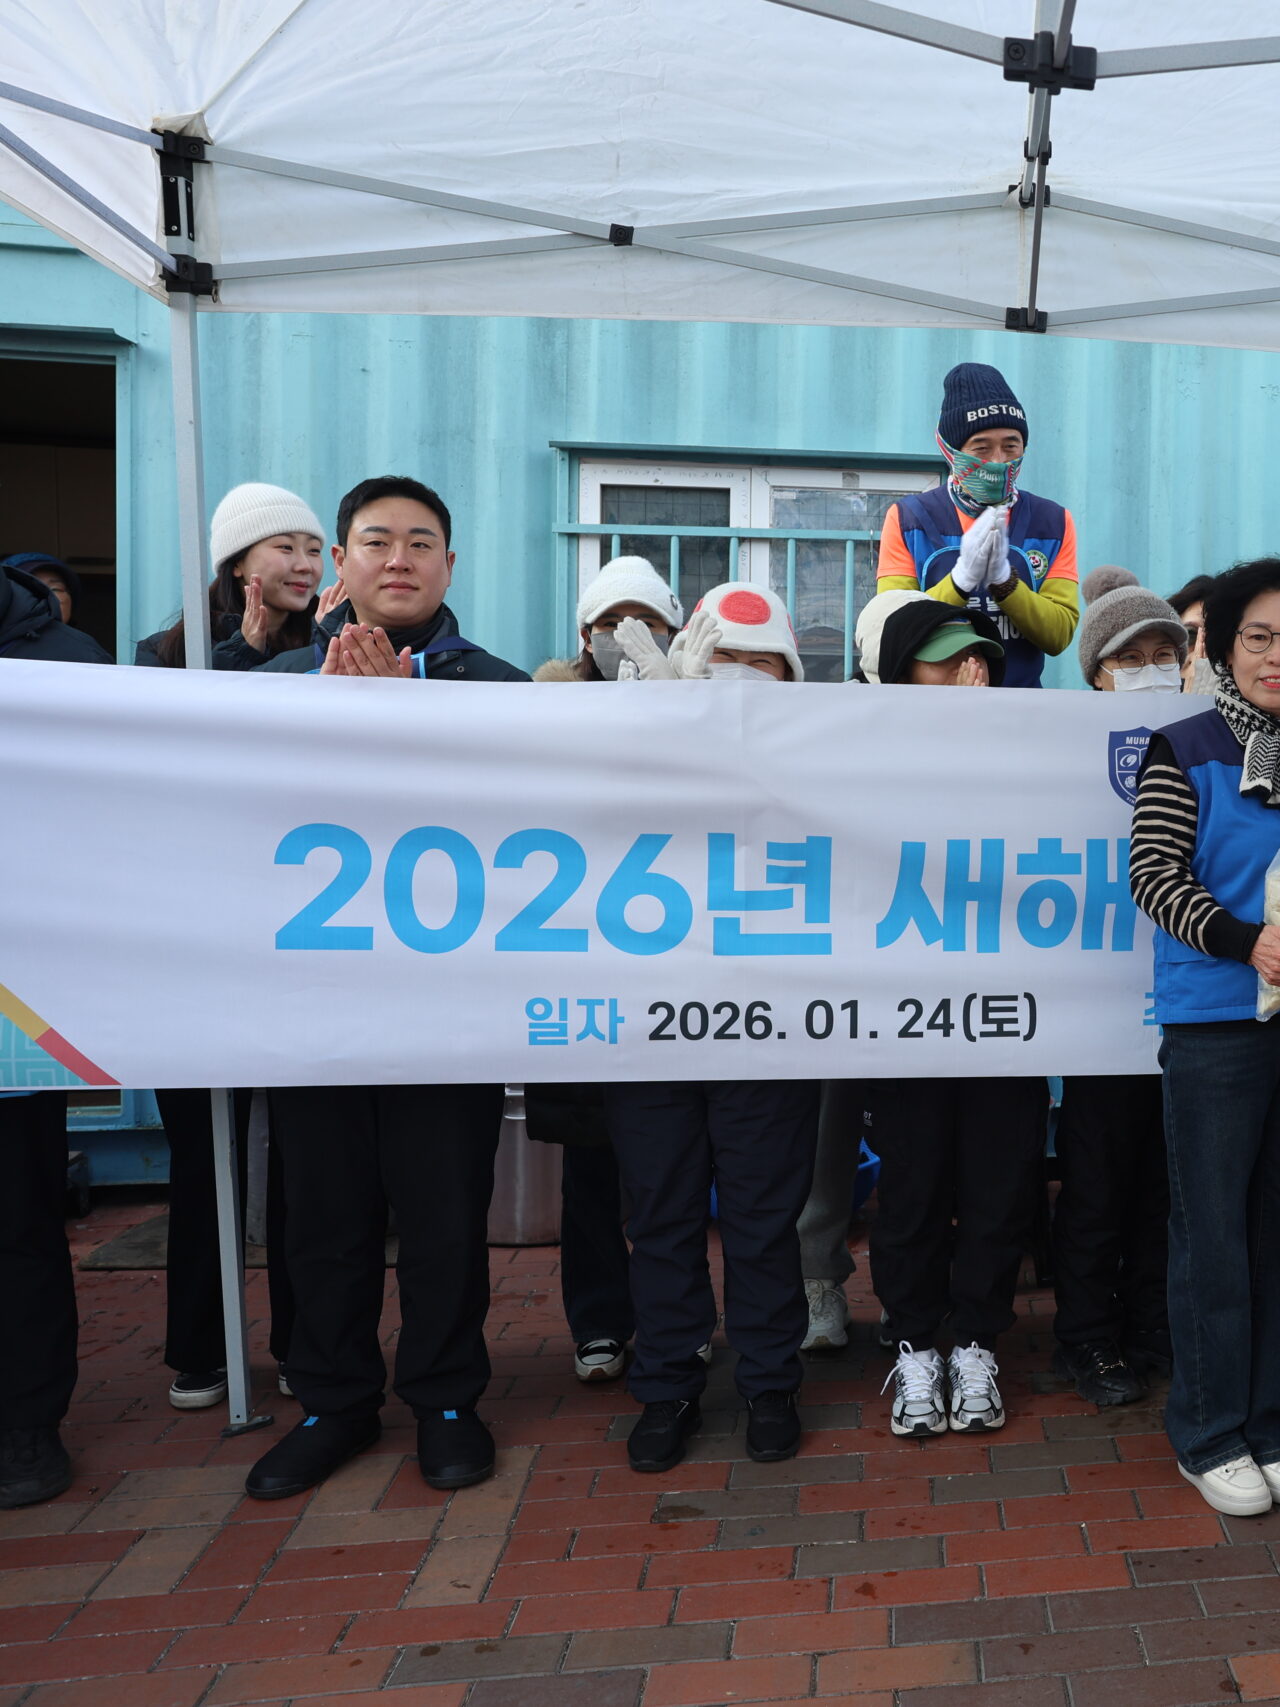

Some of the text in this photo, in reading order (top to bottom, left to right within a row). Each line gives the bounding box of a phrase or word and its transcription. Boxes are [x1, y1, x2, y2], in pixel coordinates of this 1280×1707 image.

[273, 822, 833, 957] 2026년
[875, 837, 1136, 954] 새해
[524, 991, 1038, 1046] 일자 2026. 01. 24(토)
